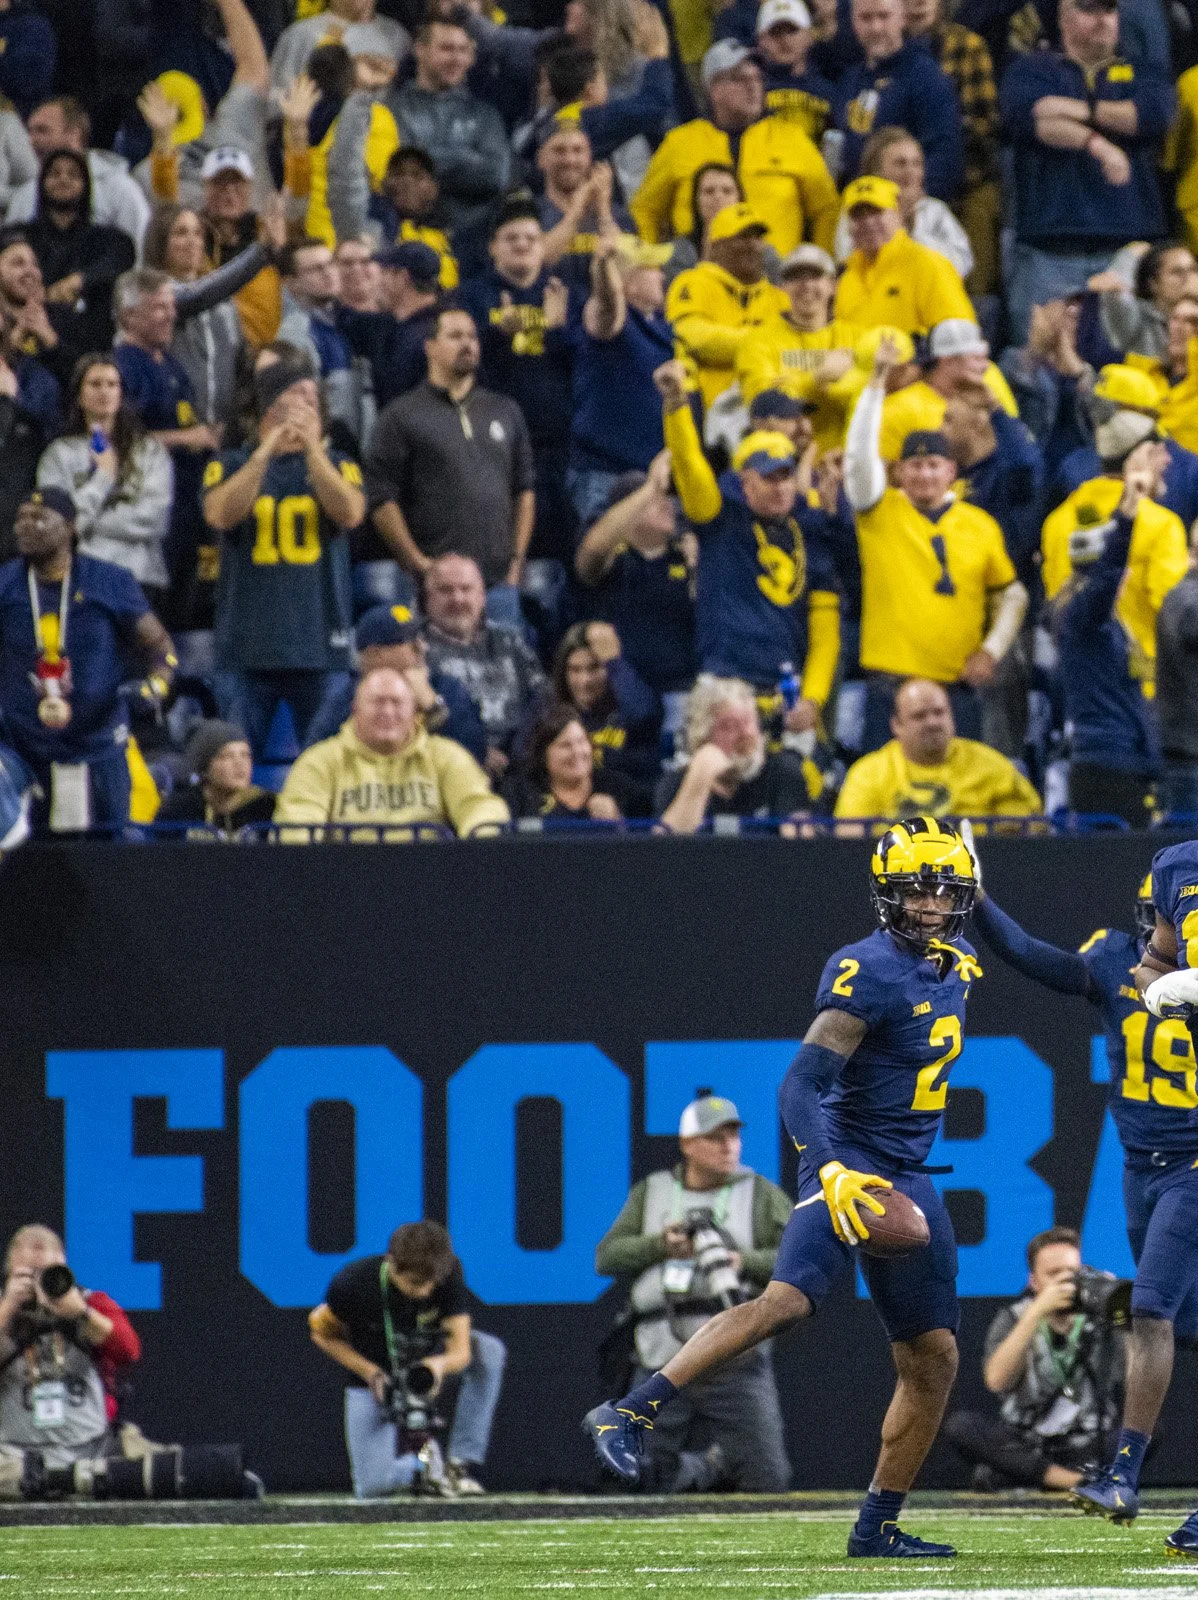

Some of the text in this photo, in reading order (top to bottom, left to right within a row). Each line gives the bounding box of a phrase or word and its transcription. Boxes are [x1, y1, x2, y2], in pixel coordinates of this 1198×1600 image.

[252, 495, 321, 565] 10
[929, 535, 957, 597] 1
[339, 781, 438, 817] PURDUE
[831, 958, 861, 997] 2
[911, 1014, 962, 1111] 2
